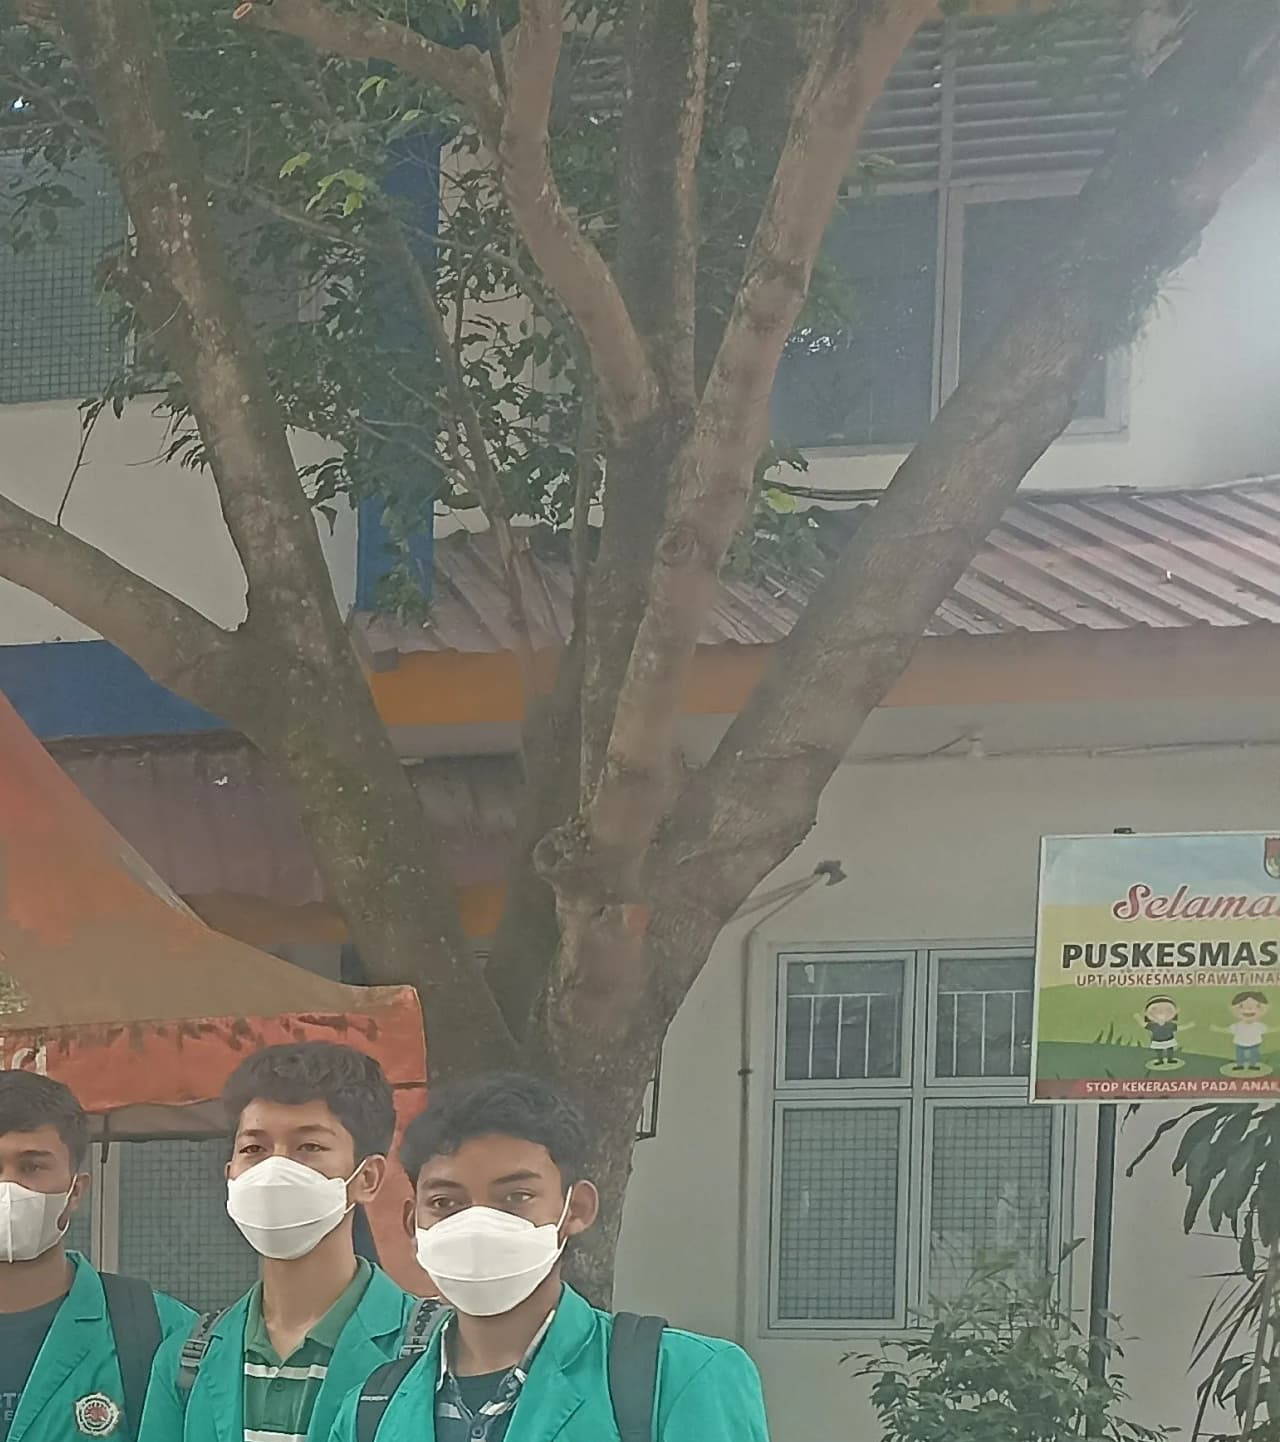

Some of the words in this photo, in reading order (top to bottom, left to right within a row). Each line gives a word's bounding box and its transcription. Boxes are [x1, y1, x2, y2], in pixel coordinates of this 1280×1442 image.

[1112, 884, 1280, 920] Selama
[1062, 941, 1279, 968] PUSKESMAS
[1076, 974, 1102, 986] UPT
[1108, 973, 1193, 986] PUSKESMAS
[1197, 972, 1245, 985] RAWAT
[1085, 1082, 1119, 1093] STOP
[1122, 1081, 1198, 1092] KEKERASAN
[1201, 1080, 1237, 1092] PADA
